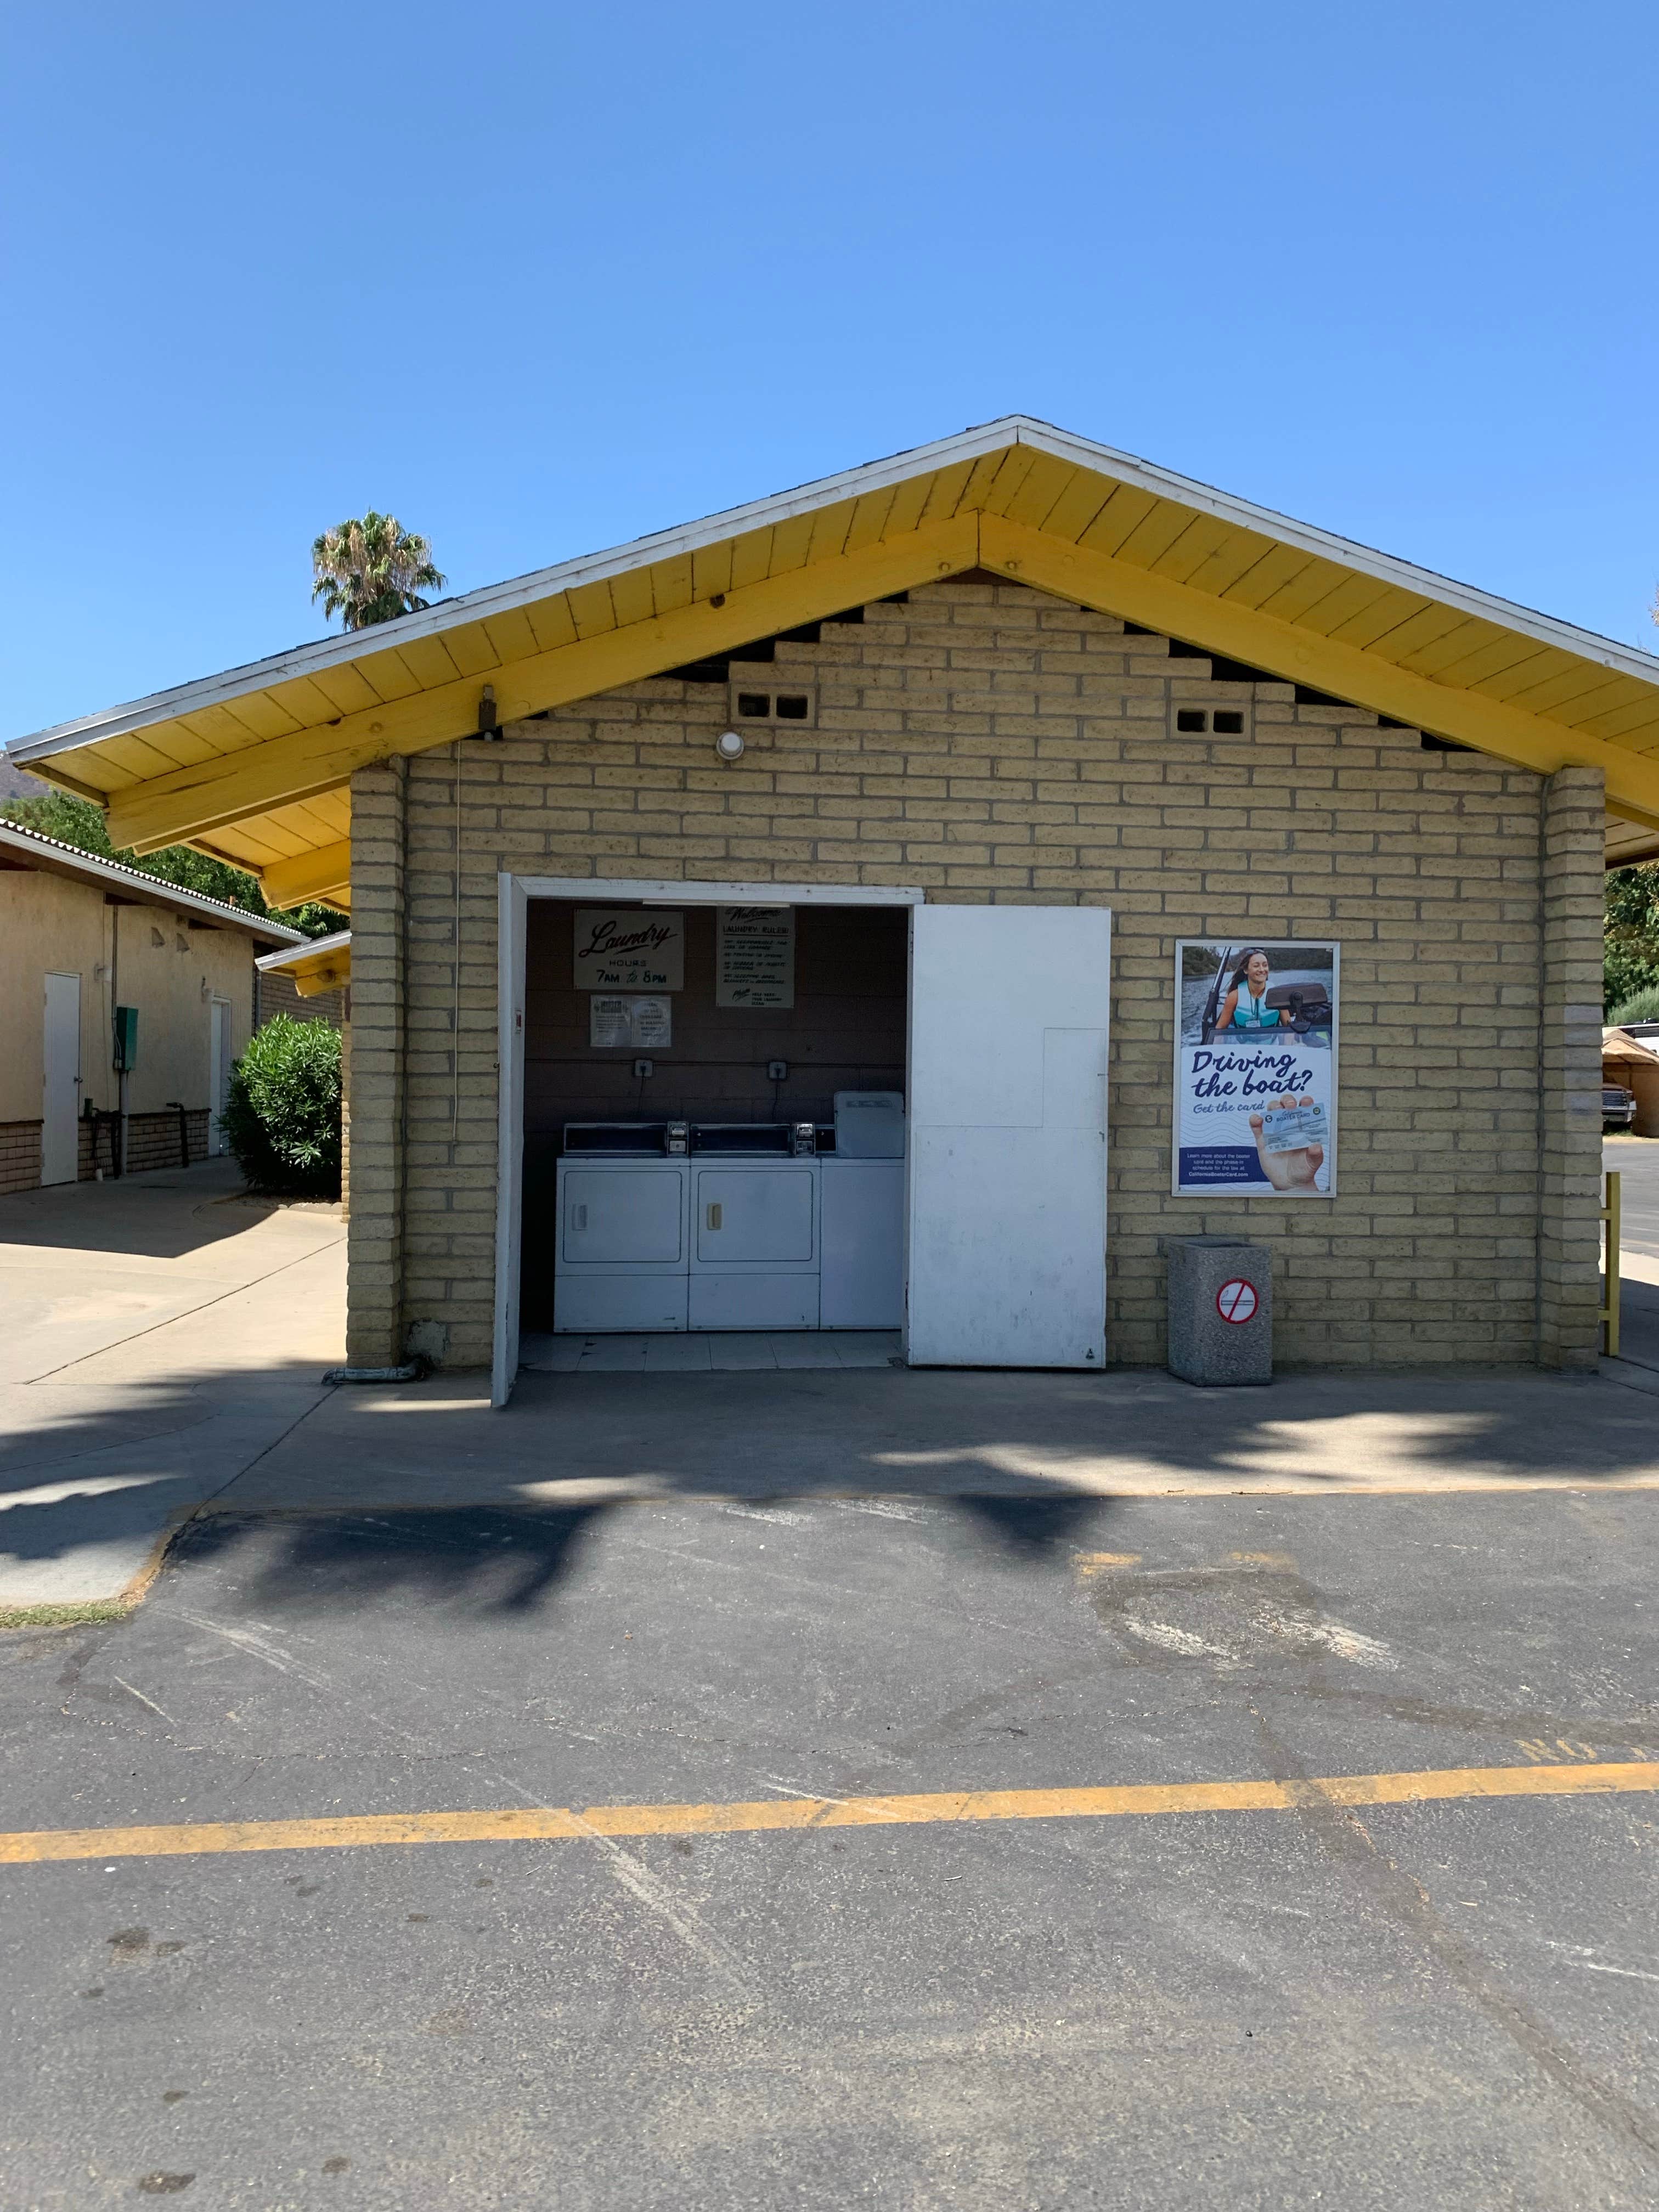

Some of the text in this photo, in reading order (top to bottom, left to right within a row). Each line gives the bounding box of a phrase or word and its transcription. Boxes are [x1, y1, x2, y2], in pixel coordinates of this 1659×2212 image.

[578, 921, 680, 957] Laundry
[596, 969, 620, 983] 7AM
[643, 970, 667, 984] 8PM
[1192, 1050, 1296, 1077] Driving
[1191, 1069, 1312, 1097] the boat?
[1193, 1100, 1264, 1114] Get the card
